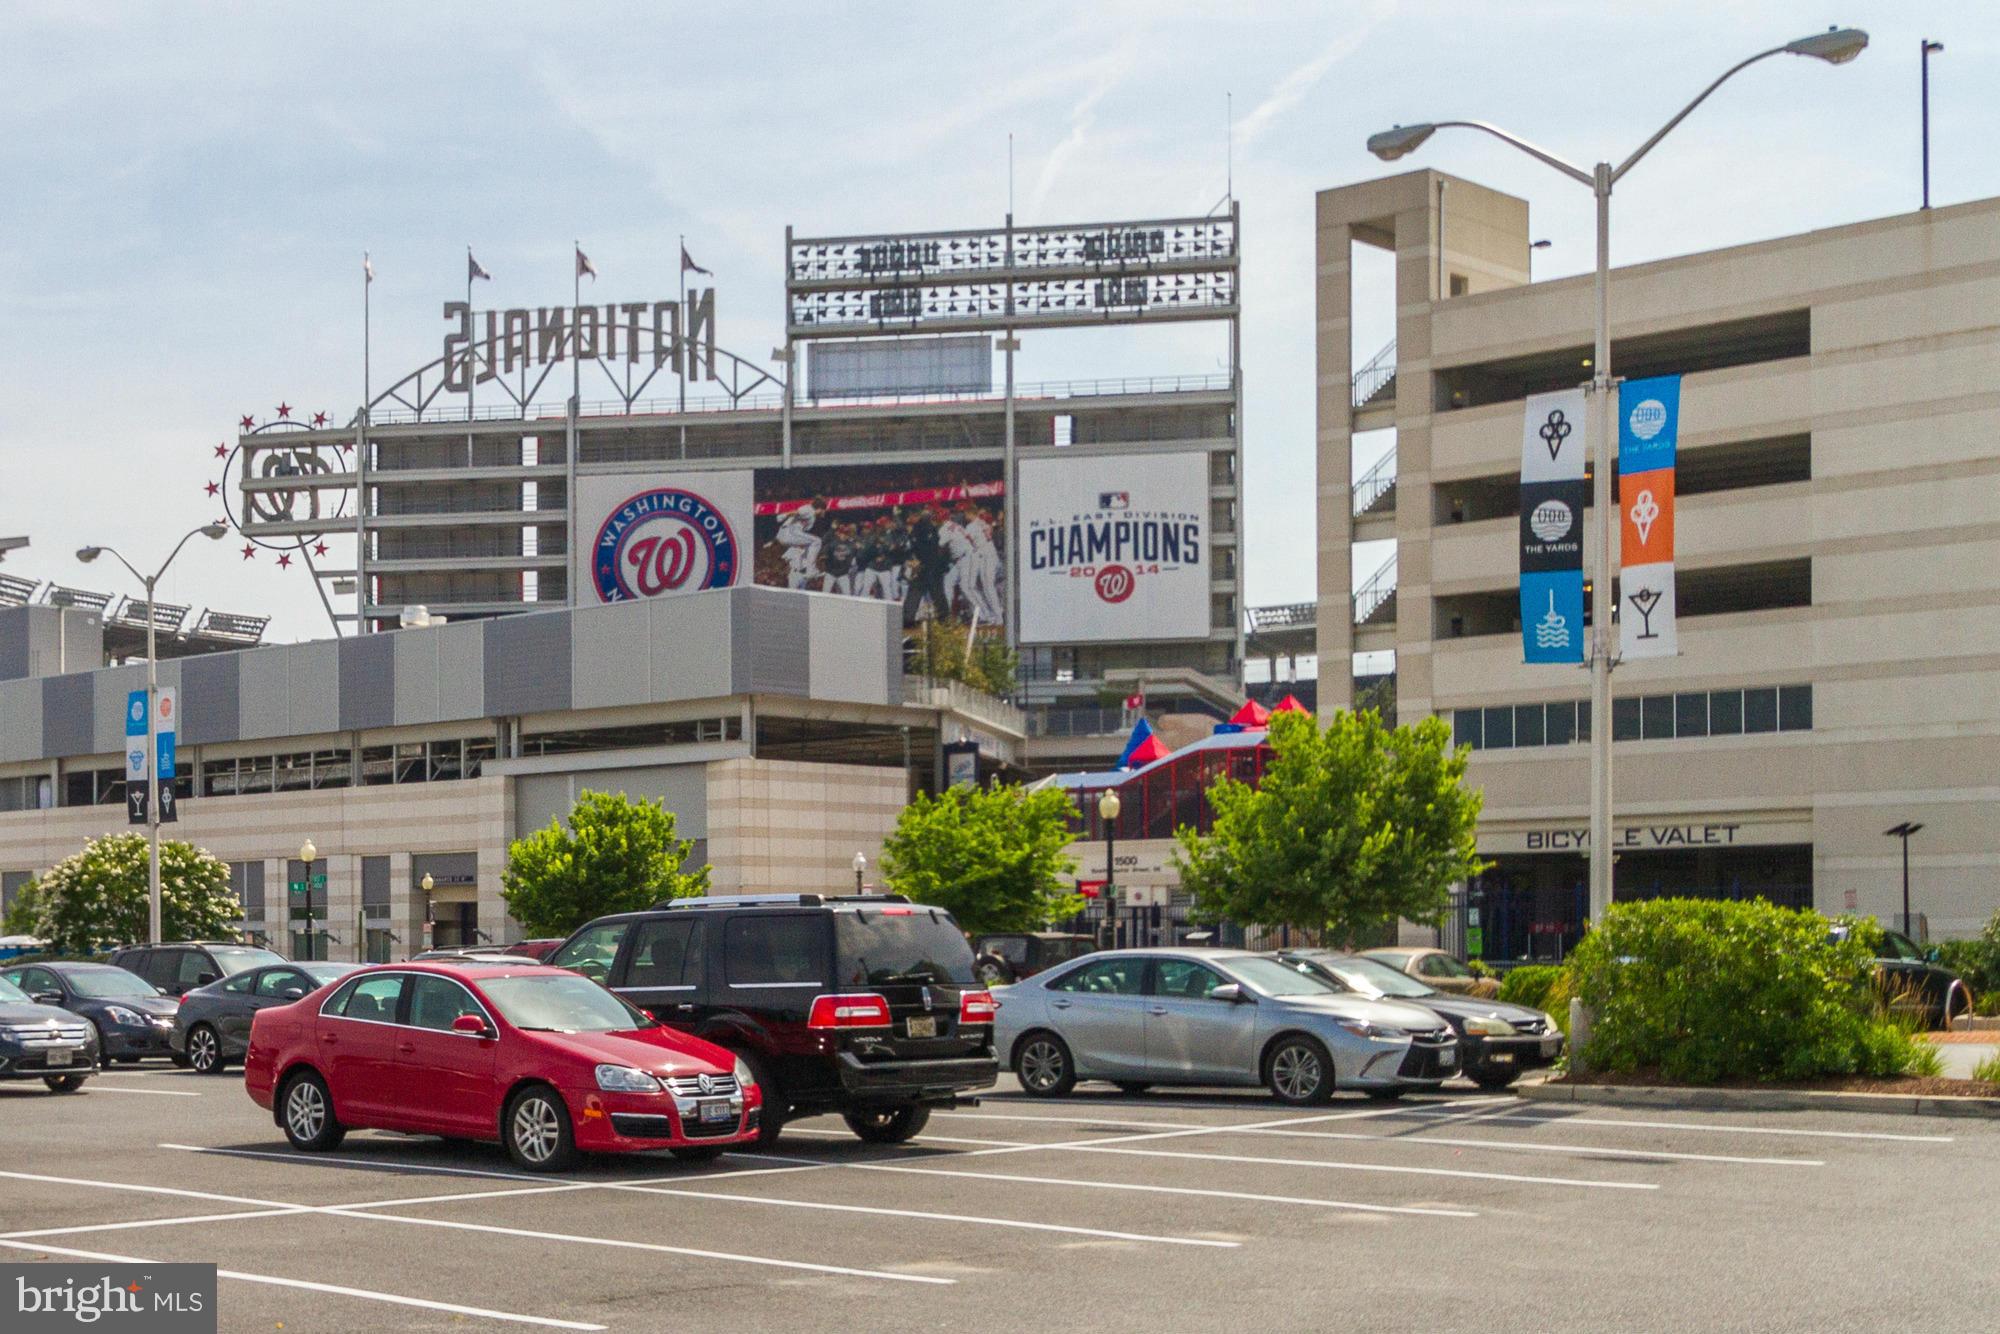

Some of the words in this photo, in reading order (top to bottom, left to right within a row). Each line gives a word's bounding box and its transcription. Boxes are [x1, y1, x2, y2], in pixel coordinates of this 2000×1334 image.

[600, 494, 727, 547] WASHINGTON
[1072, 512, 1114, 522] EAST
[1123, 511, 1200, 522] DIVISION
[1030, 520, 1200, 570] CHAMPIONS
[1525, 544, 1543, 554] THE
[1545, 542, 1578, 553] YARDS
[1527, 828, 1641, 850] BICYLE
[1650, 825, 1740, 845] VALET
